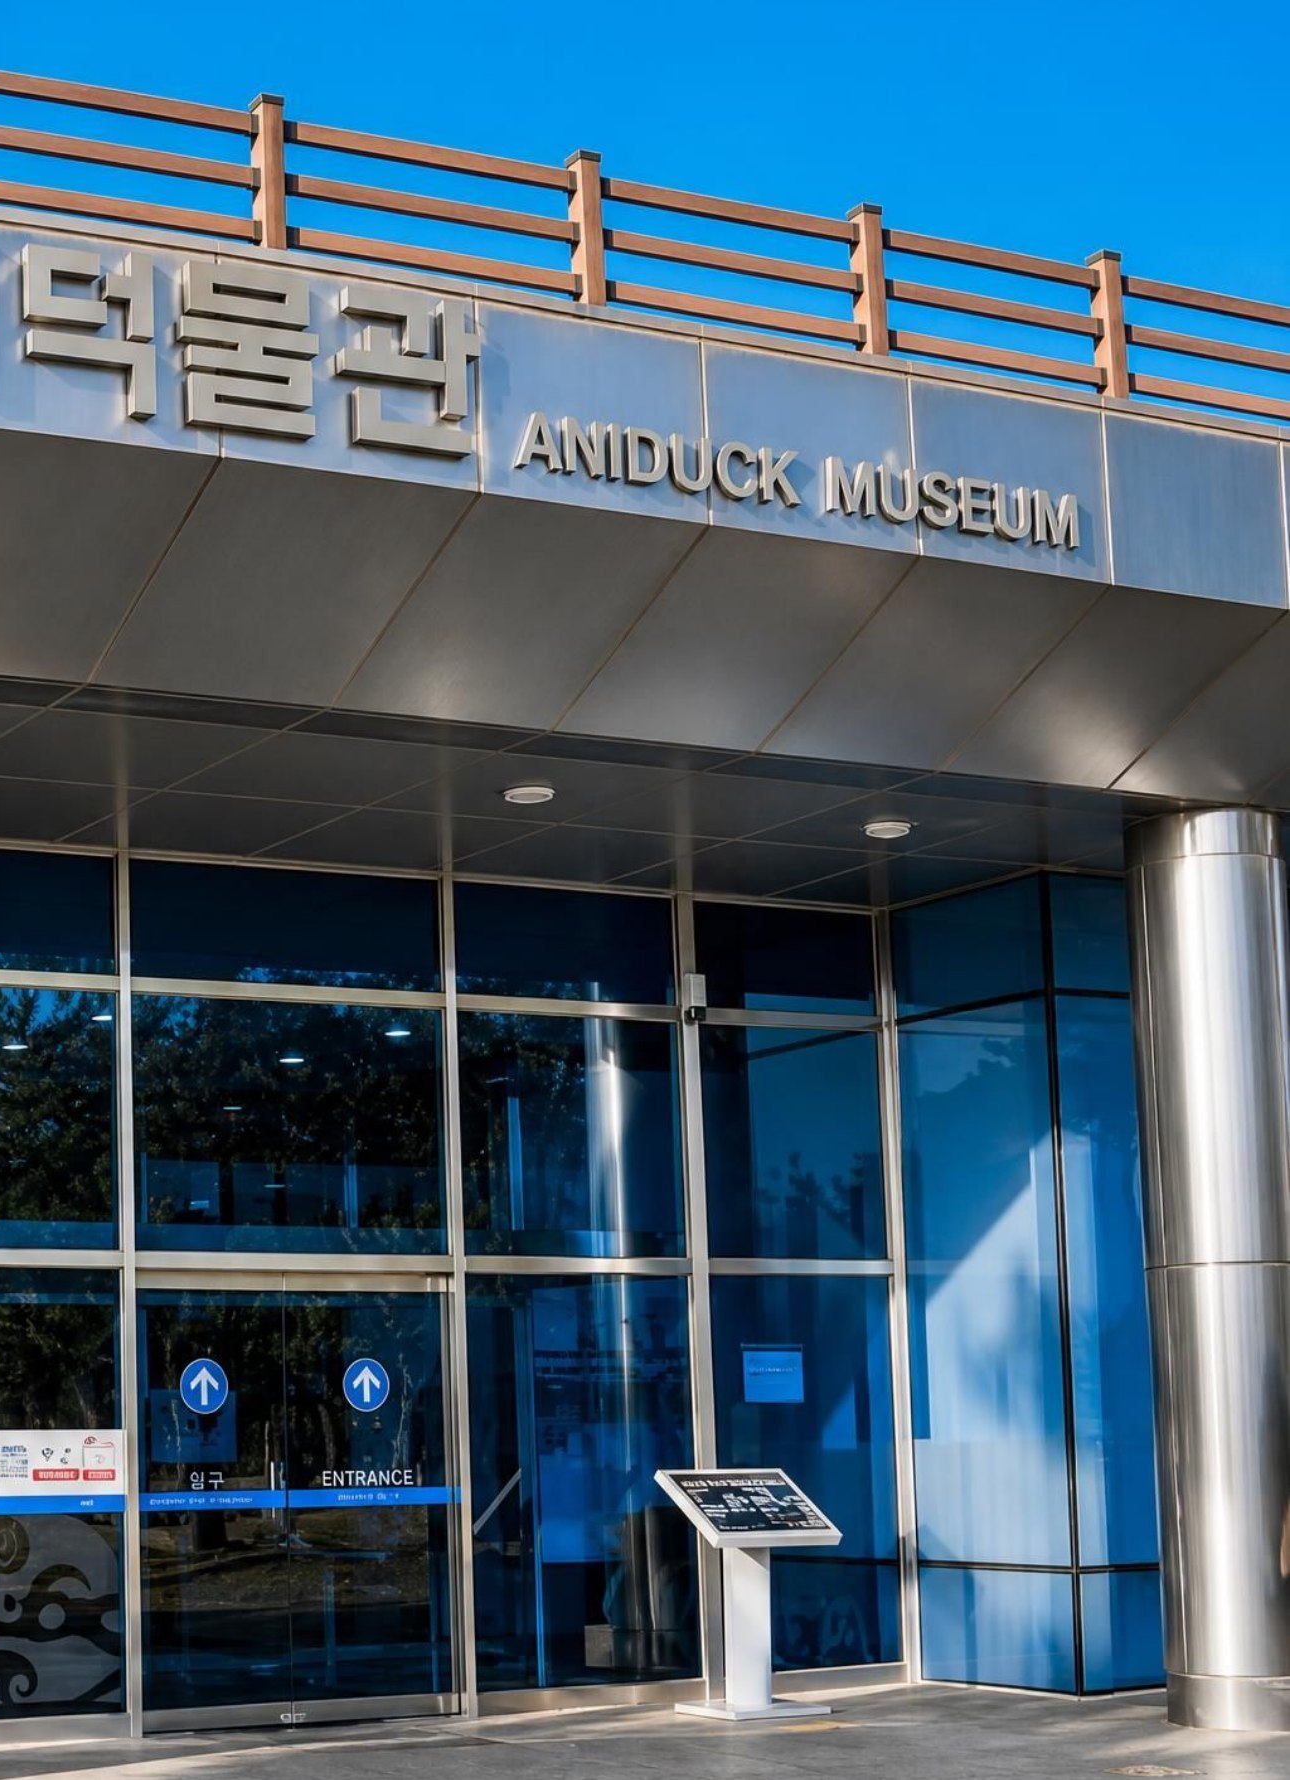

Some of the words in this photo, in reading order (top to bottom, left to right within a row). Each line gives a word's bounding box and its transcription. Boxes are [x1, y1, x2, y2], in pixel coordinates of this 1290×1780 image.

[513, 411, 802, 508] ANIDUCK
[824, 455, 1080, 549] MUSEUM
[322, 1469, 415, 1487] ENTRANCE
